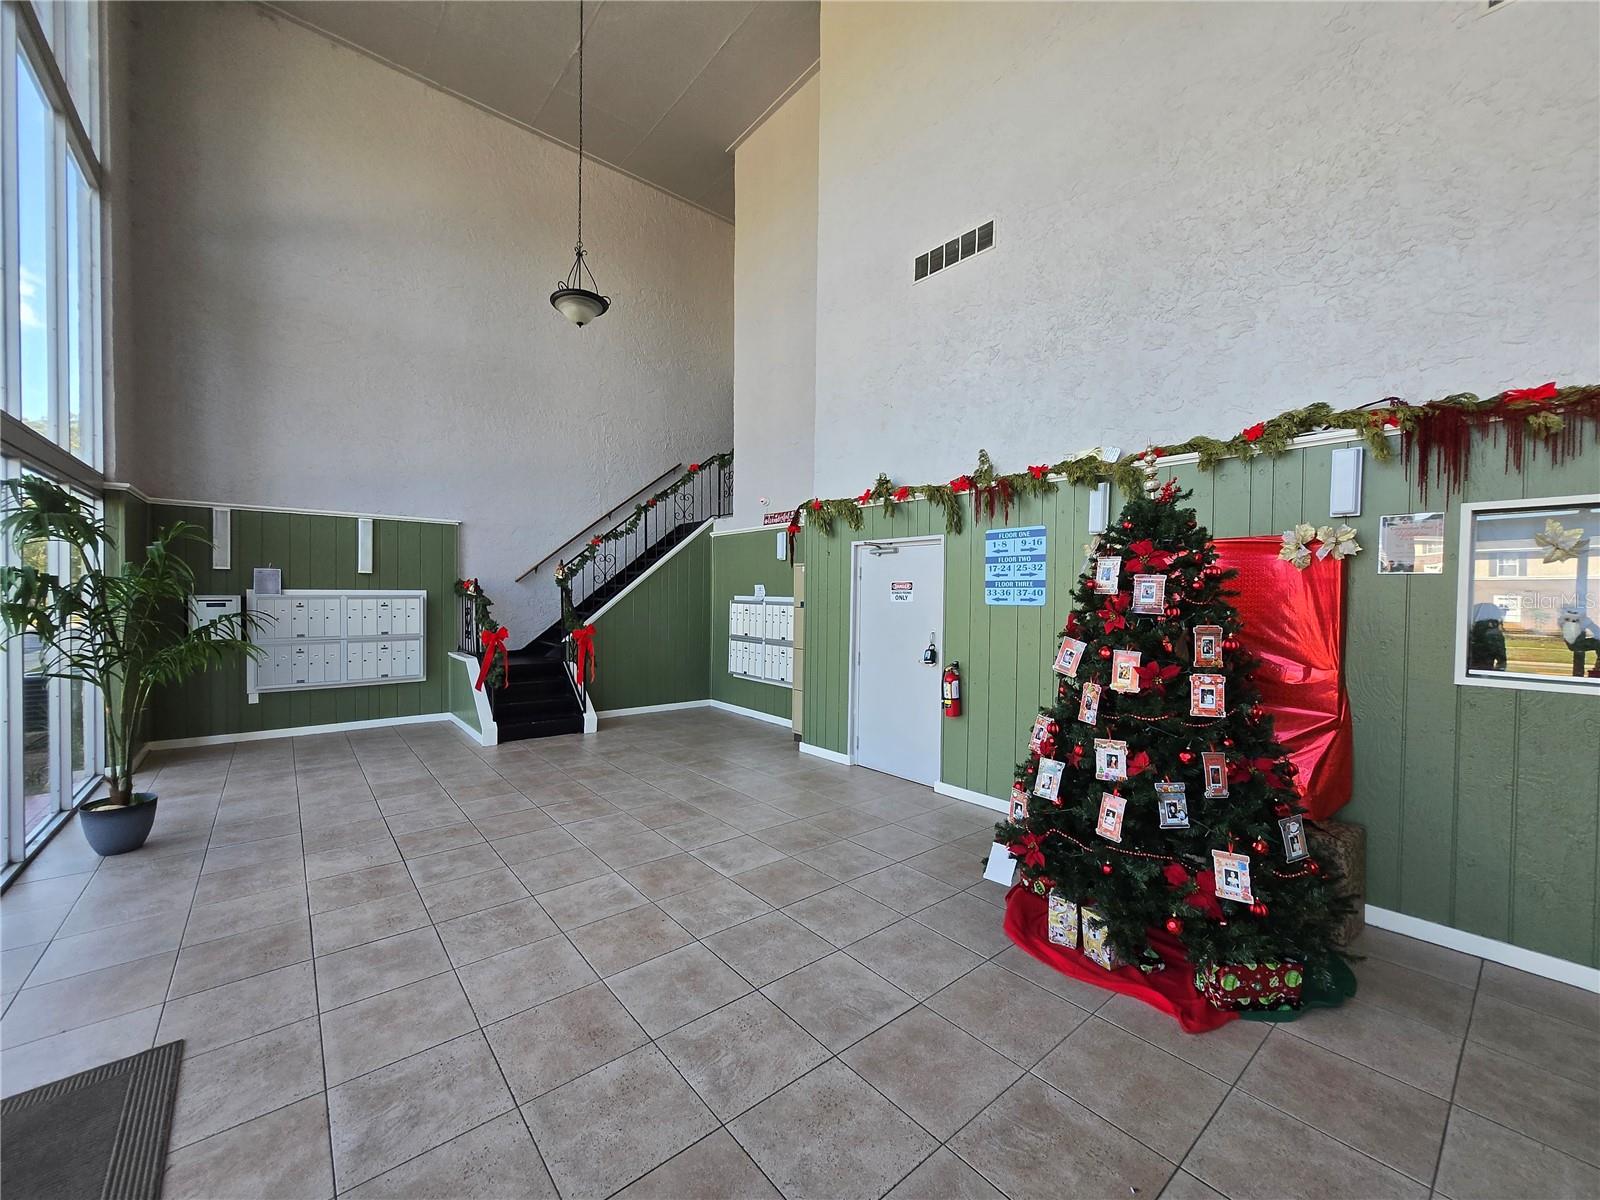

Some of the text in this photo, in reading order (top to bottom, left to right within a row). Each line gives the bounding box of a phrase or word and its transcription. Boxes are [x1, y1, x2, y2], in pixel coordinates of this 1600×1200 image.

[998, 531, 1017, 539] FLOOR
[993, 540, 1007, 548] 1-8
[1021, 538, 1043, 546] 9-16
[989, 564, 1011, 572] 17-24
[1016, 563, 1043, 572] 25-32
[987, 589, 1011, 597] 33-36
[1016, 589, 1043, 597] 37-40
